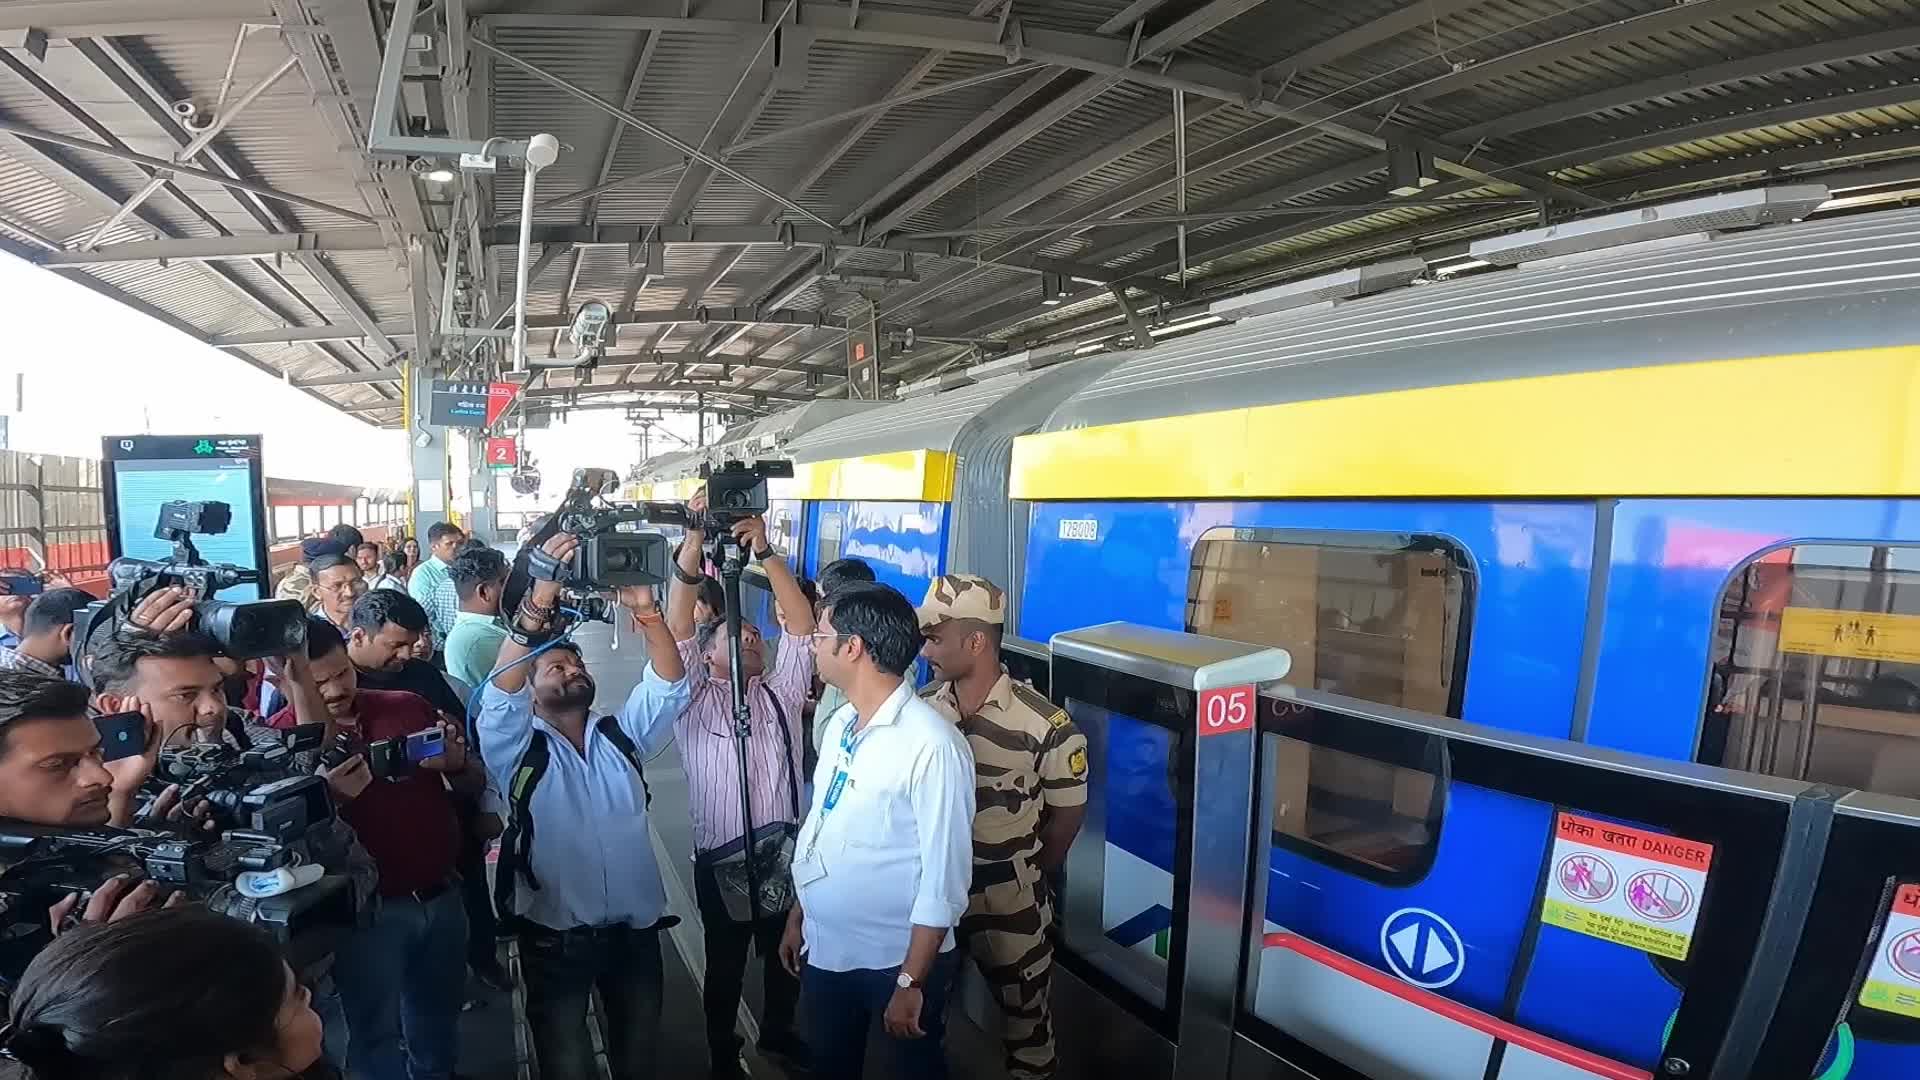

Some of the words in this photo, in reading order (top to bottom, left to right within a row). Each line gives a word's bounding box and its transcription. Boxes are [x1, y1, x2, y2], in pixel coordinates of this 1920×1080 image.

[496, 447, 508, 460] 2
[1207, 692, 1247, 727] 05
[1560, 816, 1594, 839] धोका
[1601, 828, 1638, 849] खतरा
[1642, 839, 1706, 864] DANGER
